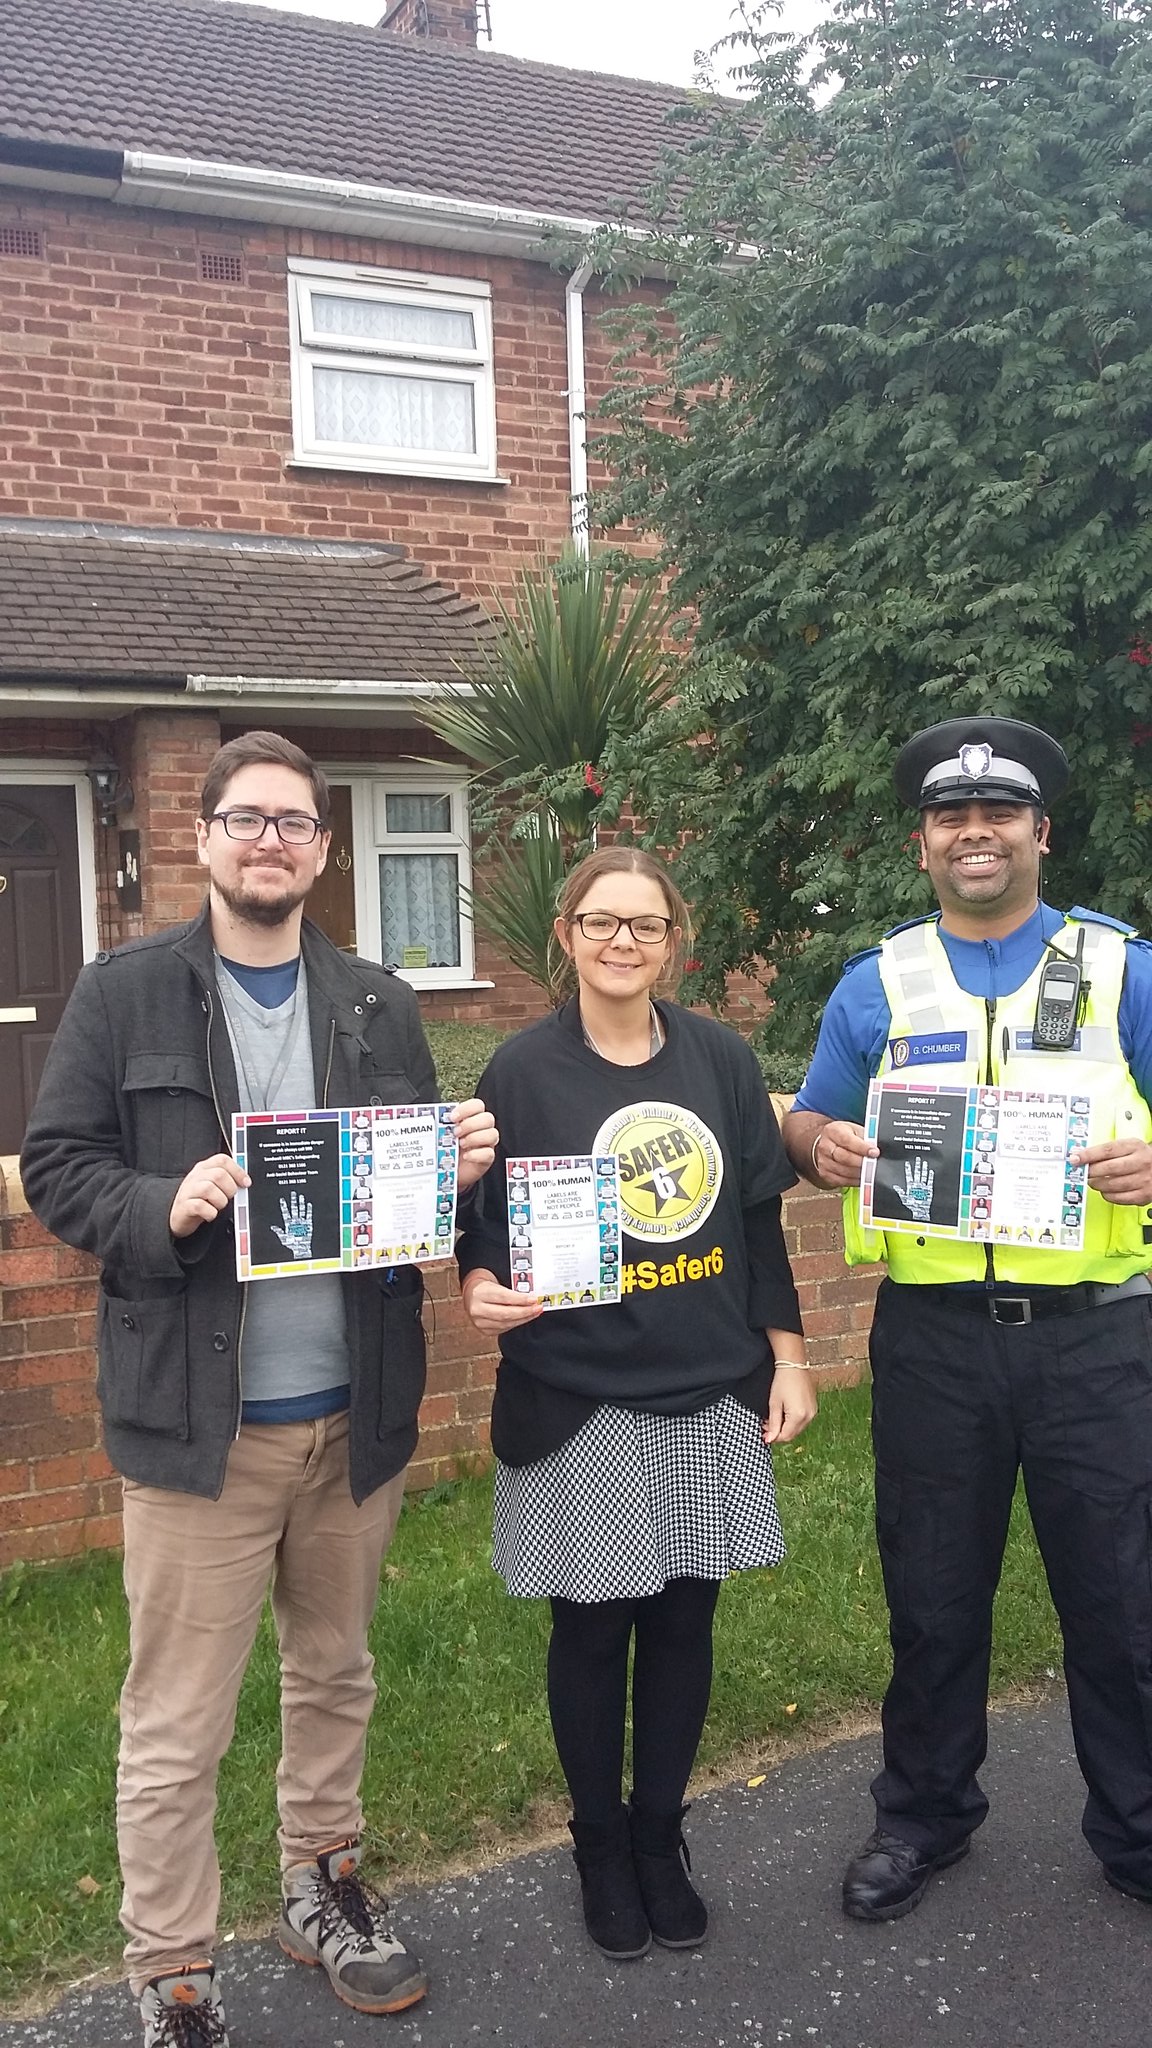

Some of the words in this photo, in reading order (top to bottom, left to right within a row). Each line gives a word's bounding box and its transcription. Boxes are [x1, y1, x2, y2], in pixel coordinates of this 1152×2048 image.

[913, 1046, 921, 1055] G.
[922, 1043, 961, 1054] CHUMBER
[1028, 1111, 1063, 1119] HUMAN
[375, 1129, 399, 1137] 100%
[400, 1125, 433, 1135] HUMAN
[618, 1129, 693, 1182] SAFER
[532, 1180, 556, 1188] 100%
[557, 1176, 591, 1186] HUMAN
[652, 1166, 677, 1200] 6
[672, 1193, 711, 1232] Smethwick
[621, 1246, 724, 1294] #Safer6
